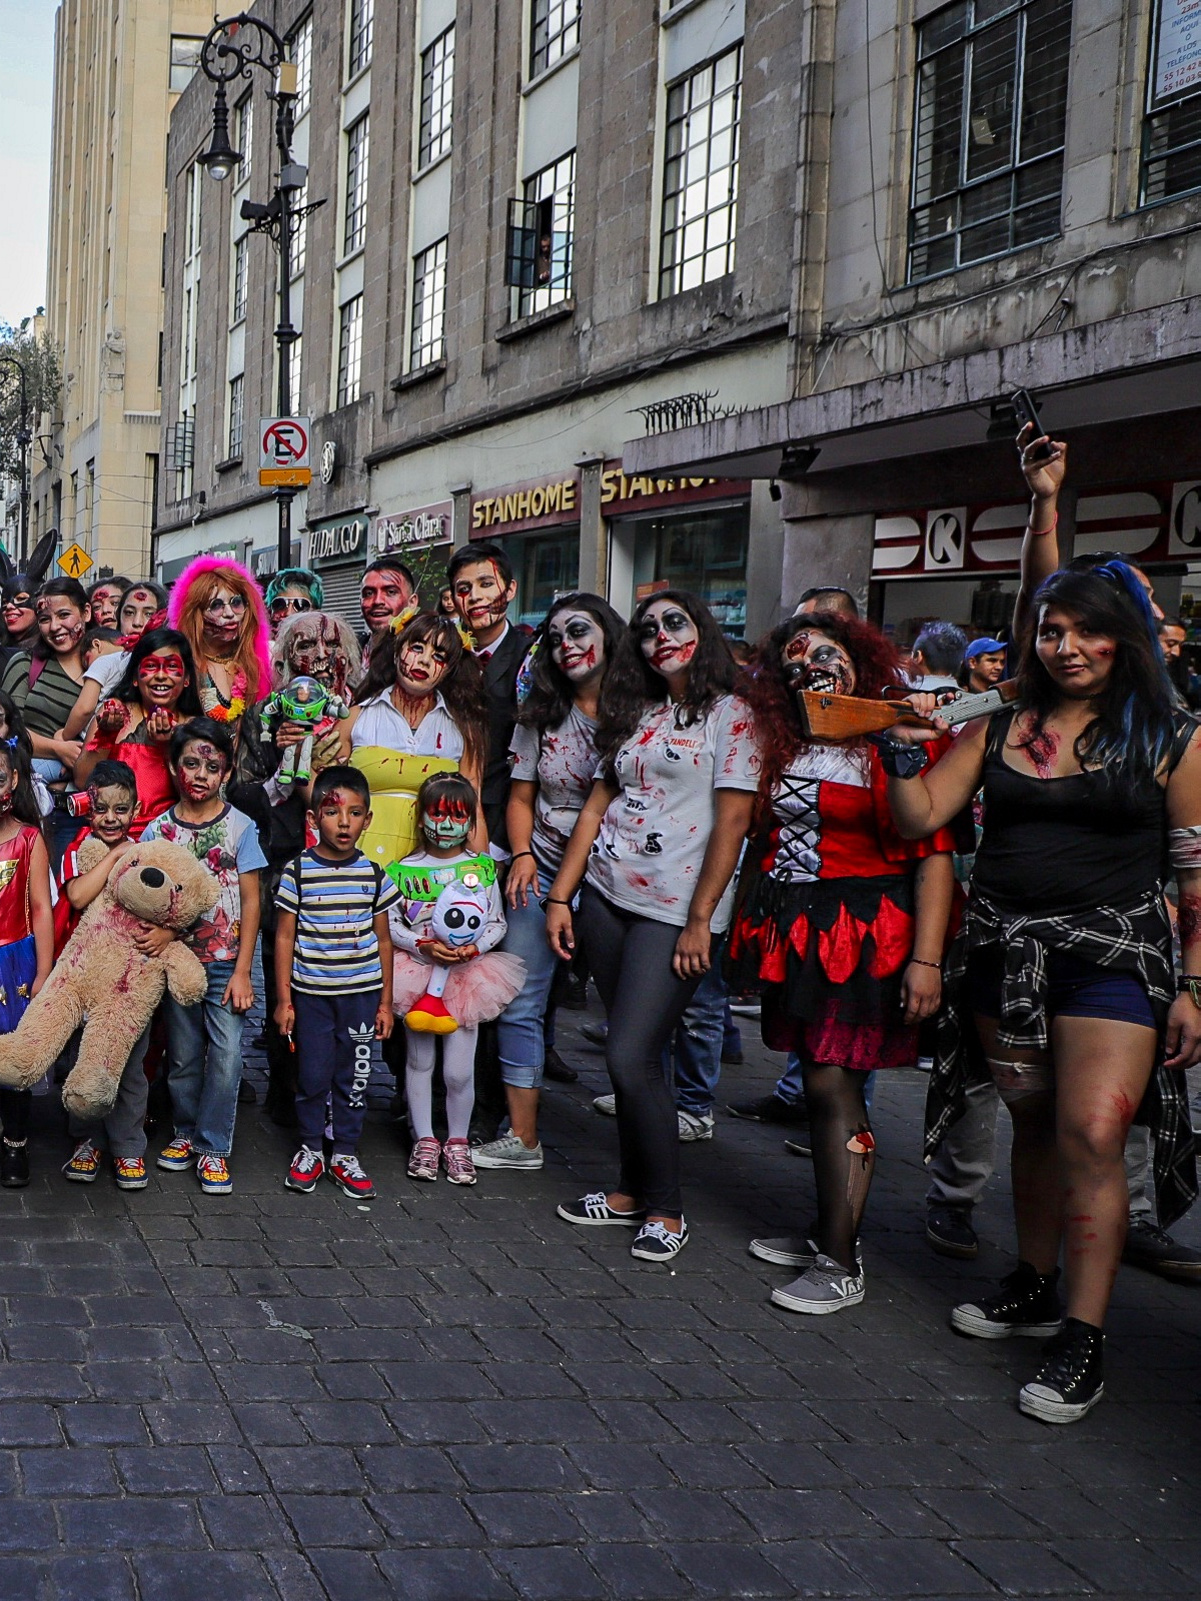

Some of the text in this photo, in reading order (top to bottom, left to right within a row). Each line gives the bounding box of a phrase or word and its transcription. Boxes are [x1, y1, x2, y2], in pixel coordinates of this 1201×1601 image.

[1184, 41, 1197, 51] LOS
[1163, 83, 1173, 92] 55
[1175, 78, 1184, 87] 10
[1186, 74, 1195, 83] 03
[1164, 71, 1174, 81] 55
[1176, 67, 1185, 76] 12
[1186, 62, 1197, 71] 42
[472, 479, 577, 529] STANHOME
[308, 520, 360, 559] HIDALGO
[933, 516, 958, 563] K
